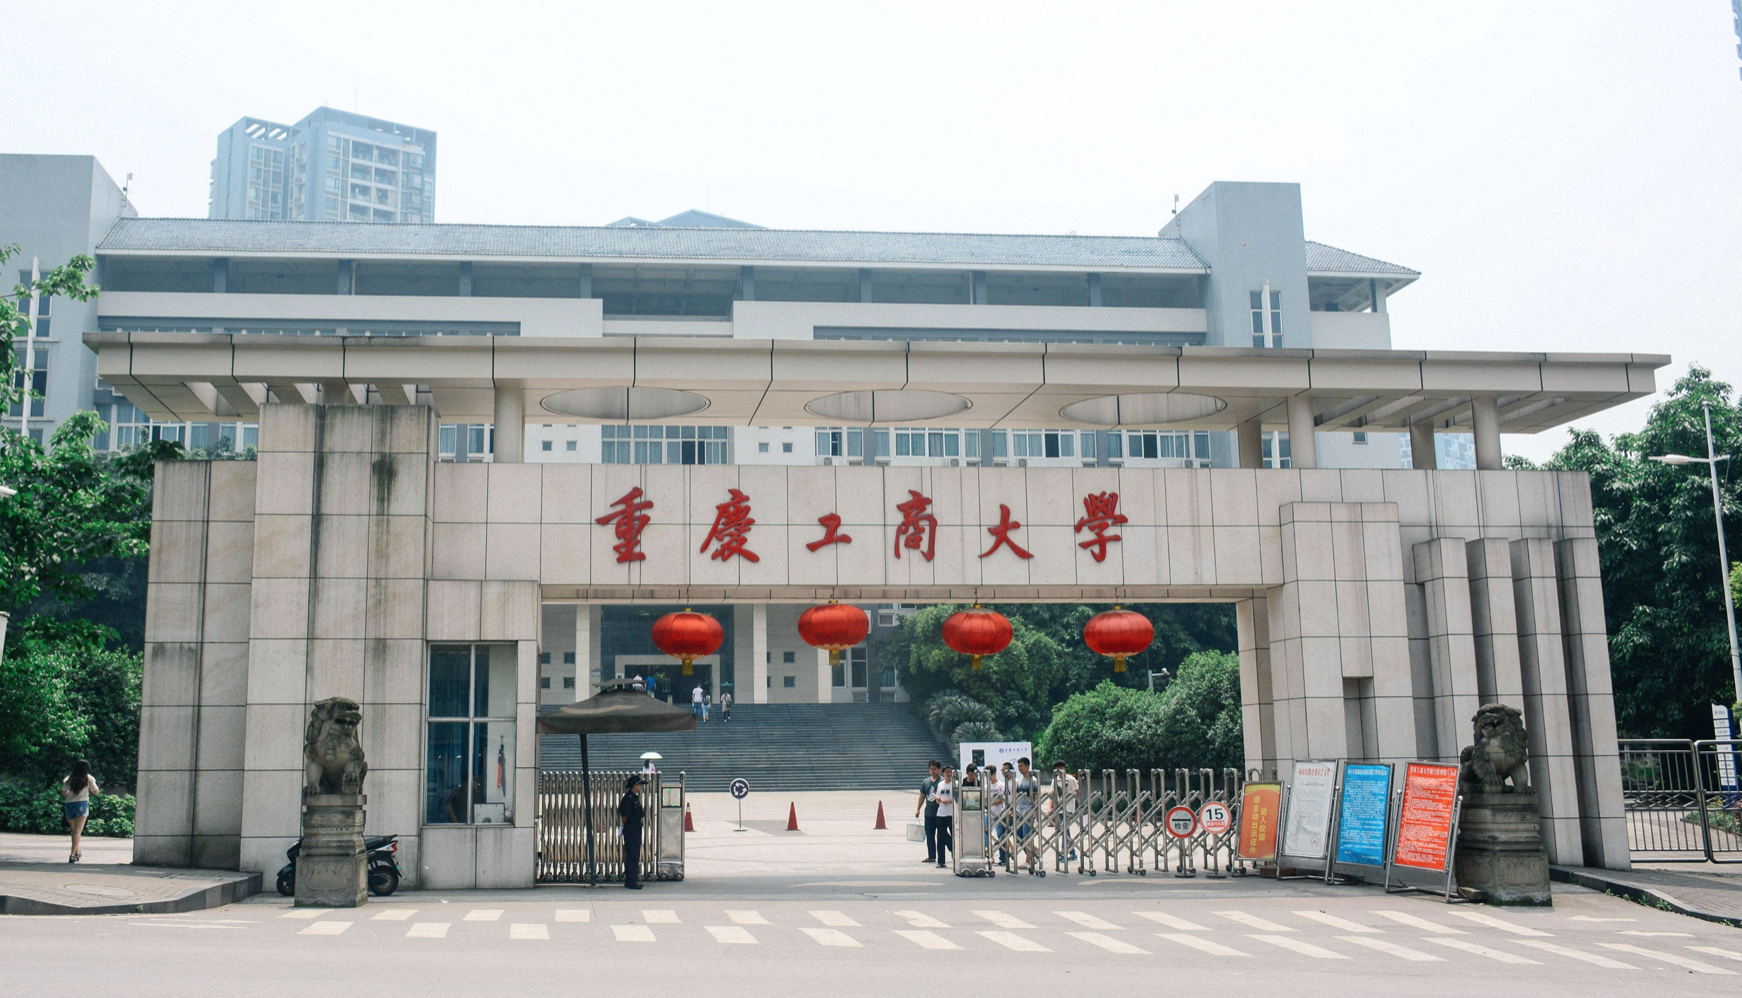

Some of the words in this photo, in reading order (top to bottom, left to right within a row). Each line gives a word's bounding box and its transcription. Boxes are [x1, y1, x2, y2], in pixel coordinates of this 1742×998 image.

[596, 487, 1128, 563] 重慶工商大學
[1174, 822, 1189, 830] 检查
[1206, 808, 1223, 820] 15
[1249, 795, 1260, 855] 请主动出示证件
[1258, 807, 1267, 841] 进入校园
